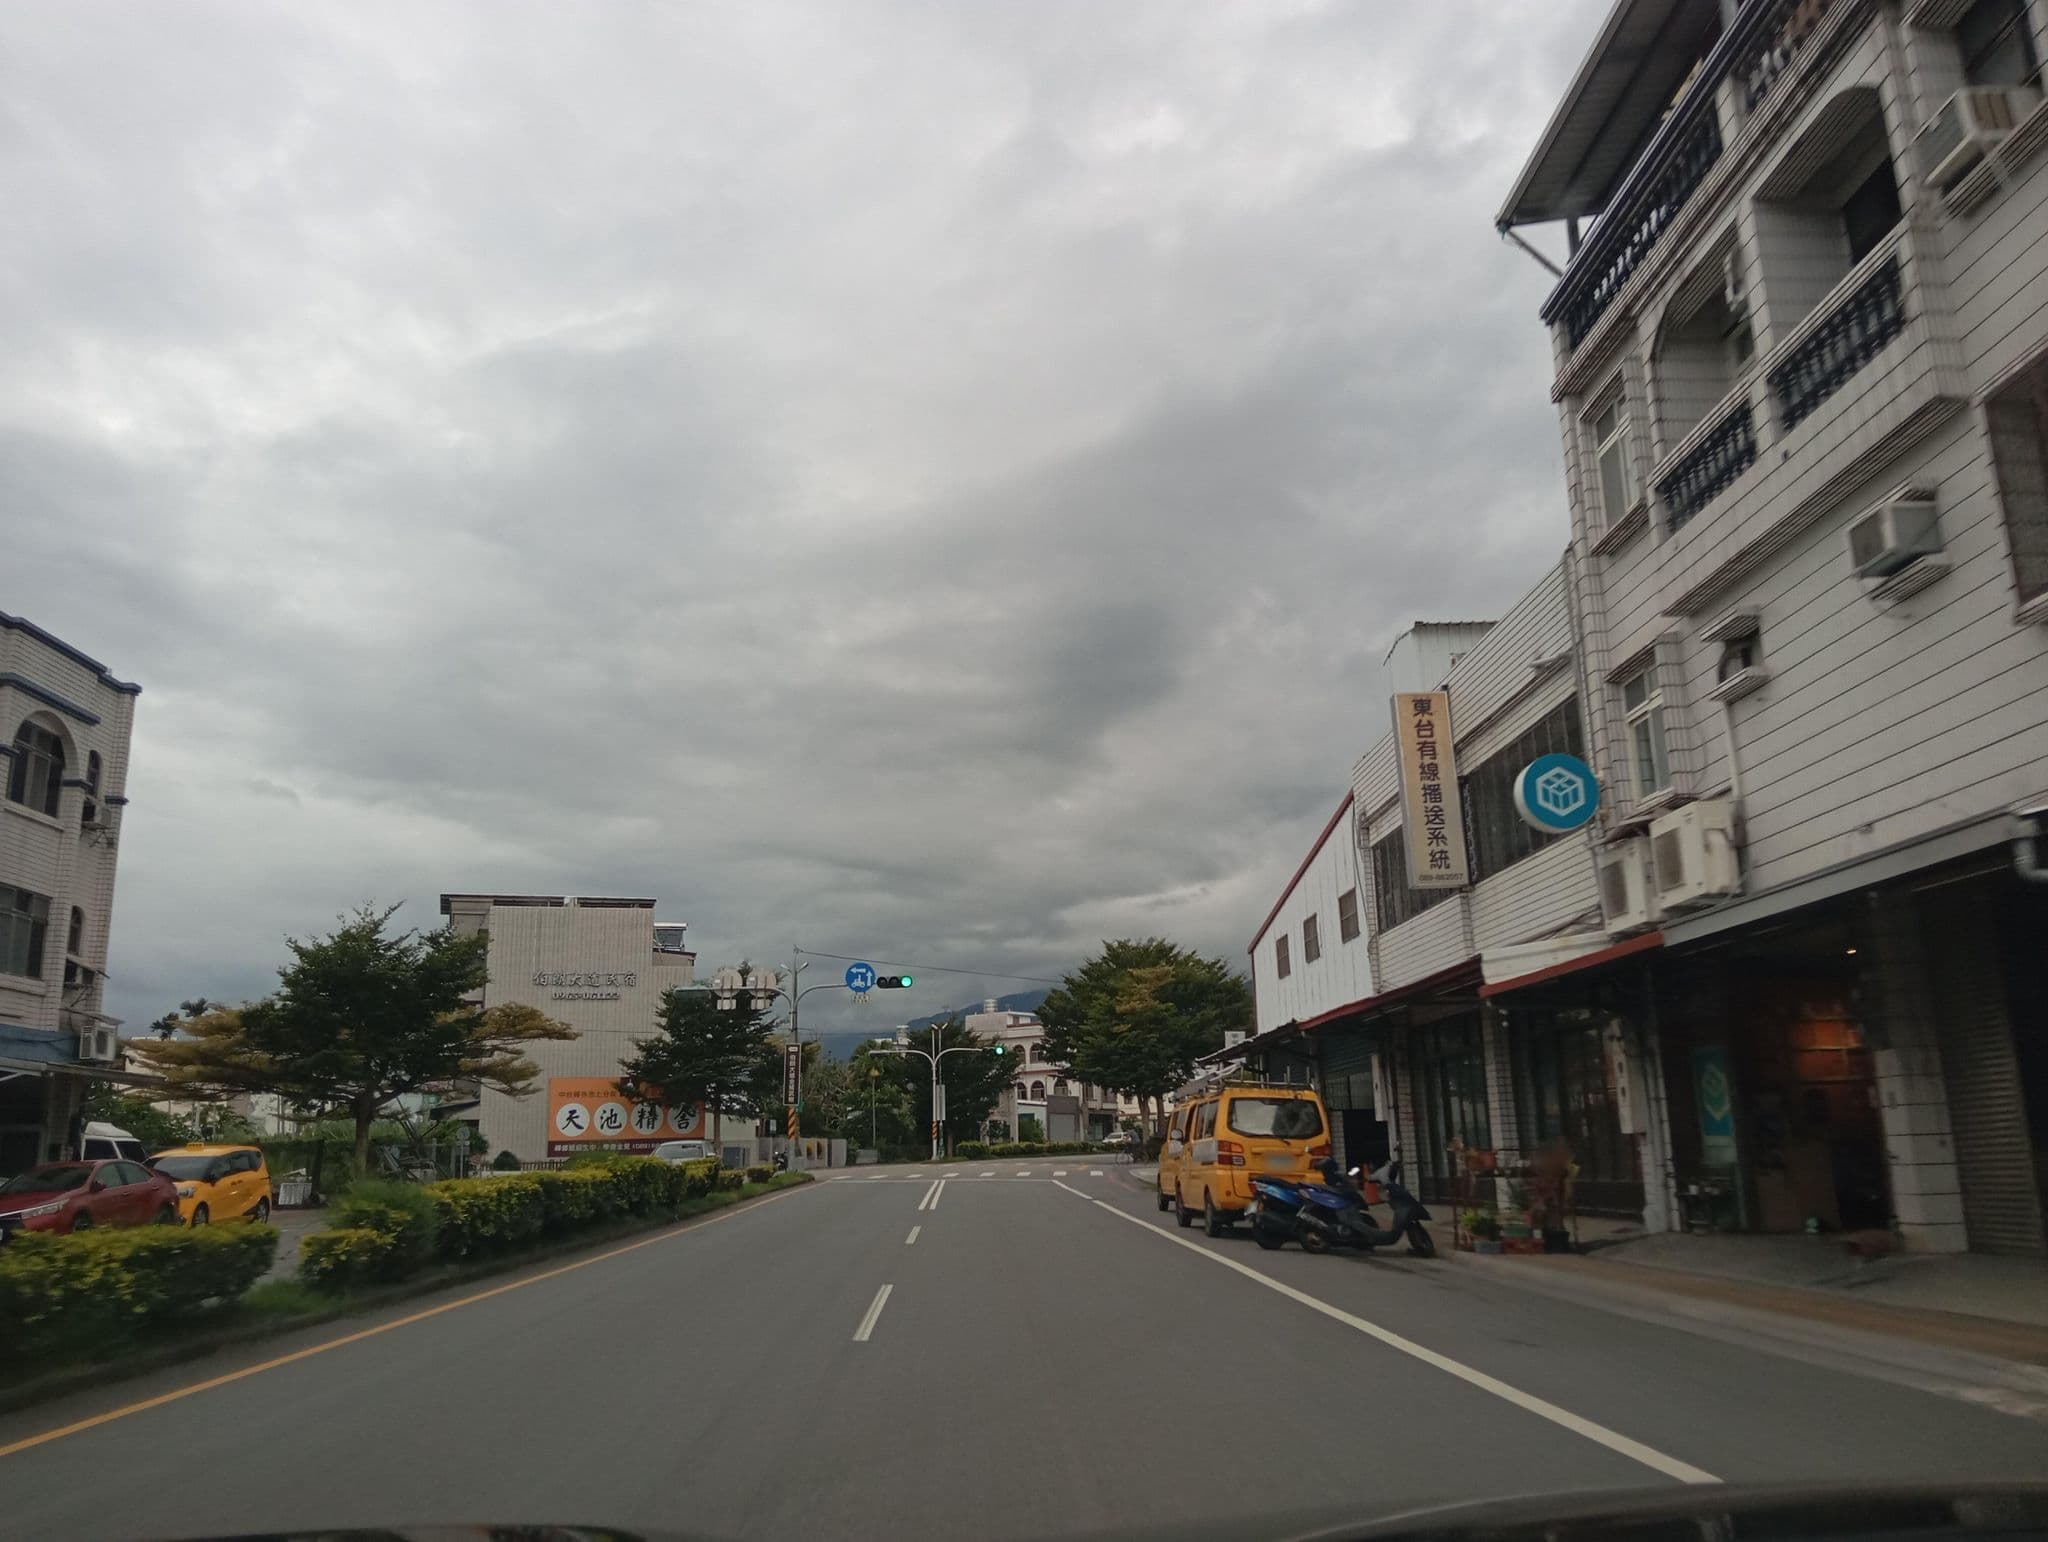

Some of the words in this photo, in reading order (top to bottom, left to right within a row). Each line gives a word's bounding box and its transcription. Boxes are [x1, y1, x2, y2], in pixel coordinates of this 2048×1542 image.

[1411, 698, 1450, 870] 東台有線播送系統
[561, 1102, 697, 1130] 天池精舍
